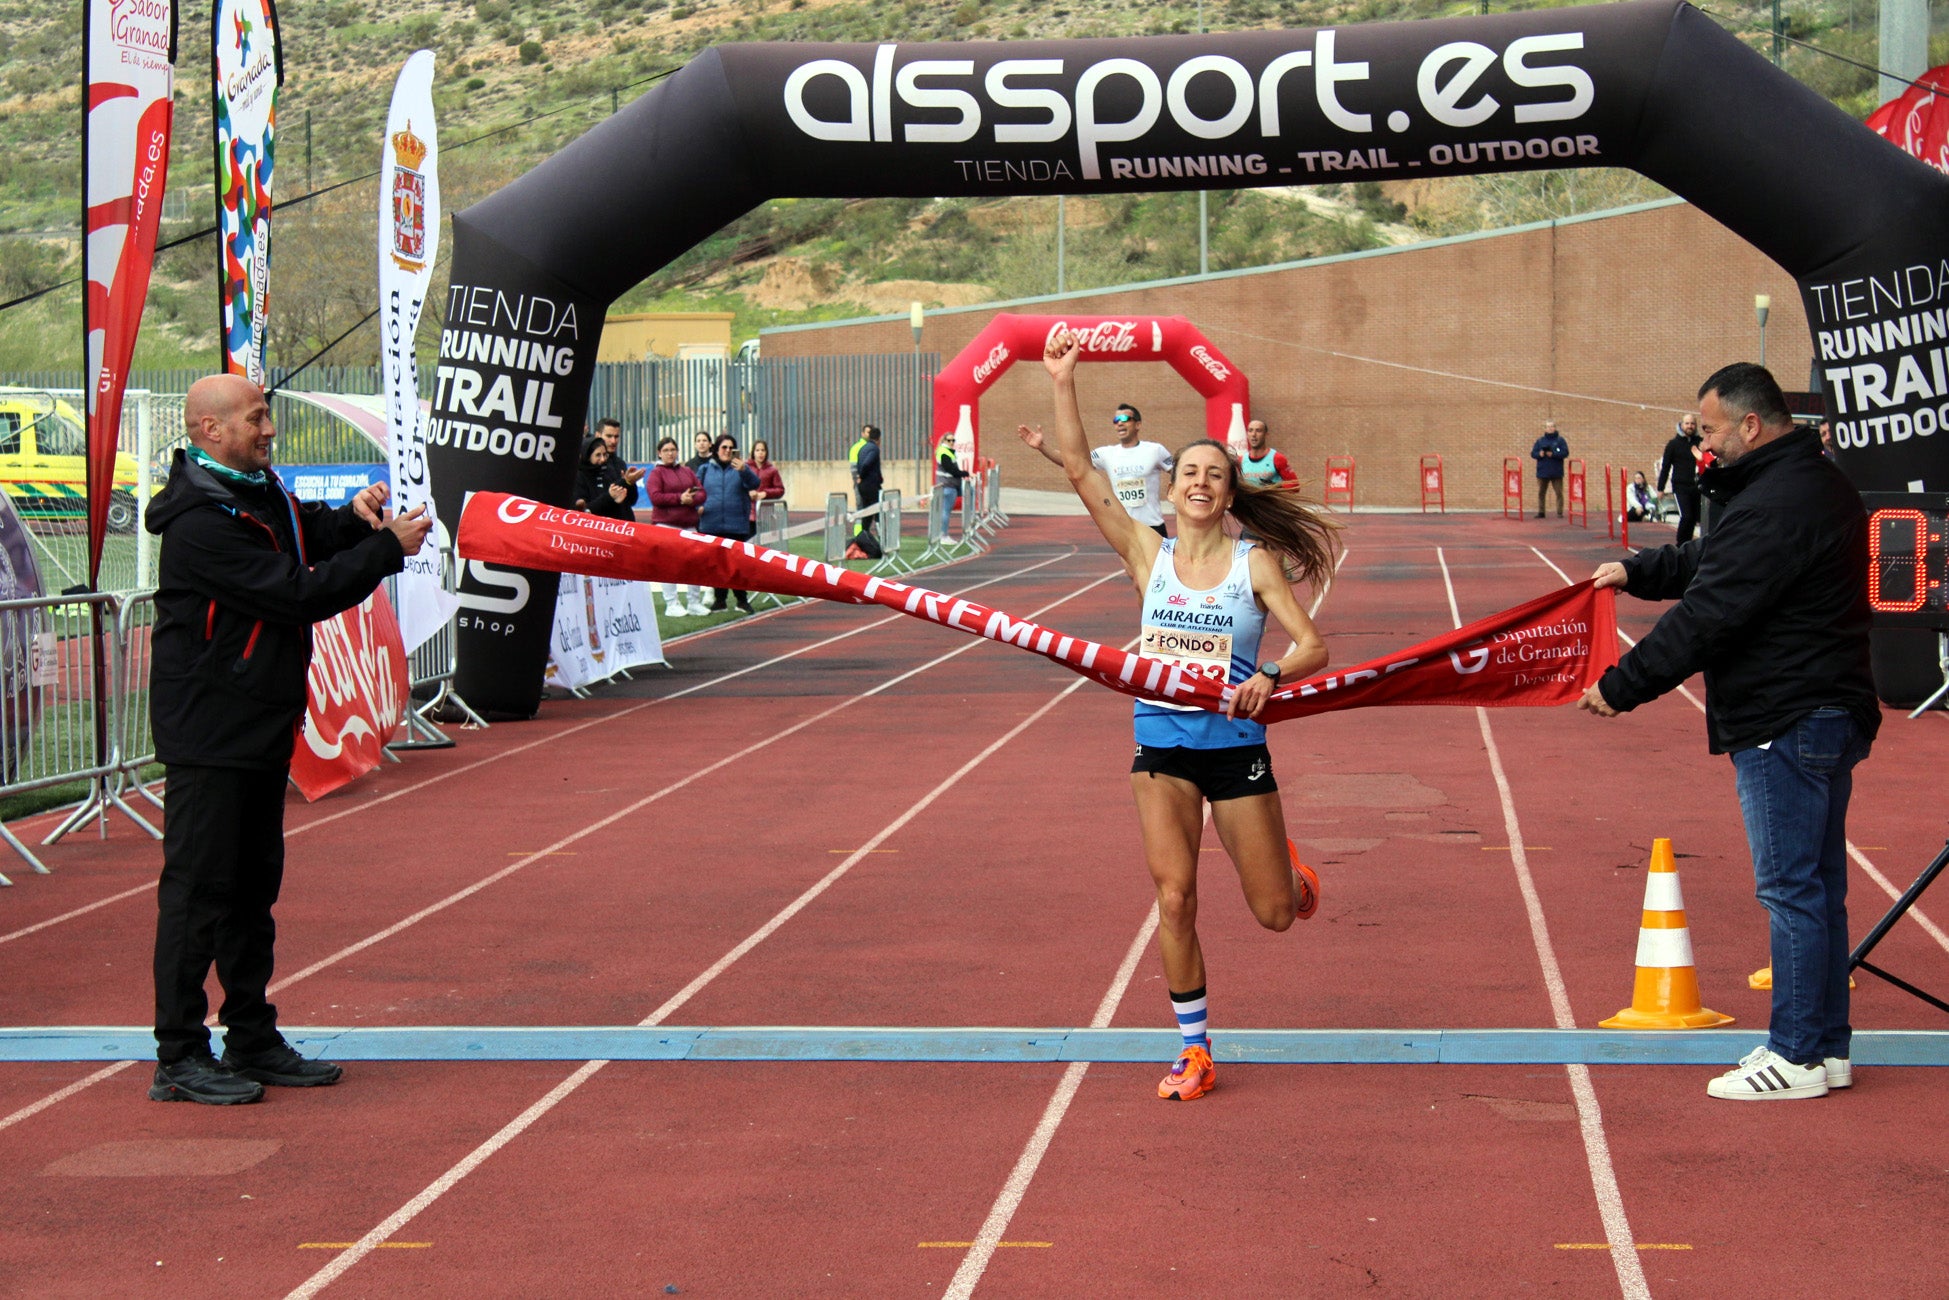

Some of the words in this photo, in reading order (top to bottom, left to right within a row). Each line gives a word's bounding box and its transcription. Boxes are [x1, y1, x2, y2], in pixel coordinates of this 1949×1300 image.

[228, 51, 272, 102] Granada
[784, 30, 1595, 180] alssport.es
[953, 159, 1075, 182] TIENDA
[1110, 153, 1268, 179] RUNNING
[1298, 148, 1399, 172] TRAIL
[1429, 135, 1602, 166] OUTDOOR
[449, 285, 578, 341] TIENDA
[440, 329, 575, 376] RUNNING
[1045, 321, 1138, 352] Cca-Cola
[1818, 308, 1949, 361] RUNNIN
[973, 341, 1010, 384] Coca-Cola
[1190, 345, 1231, 382] Coca-Cola
[1825, 347, 1949, 414] TRAI
[435, 366, 563, 428] TRAIL
[426, 417, 556, 462] OUTDOOR
[1119, 489, 1145, 501] 3095
[539, 508, 560, 523] de
[562, 510, 636, 537] Granada
[551, 534, 615, 558] Deportes
[459, 616, 514, 636] shop
[1151, 608, 1234, 628] MARACENA
[1492, 618, 1588, 644] Diputación
[1159, 635, 1215, 653] FONDO
[1496, 646, 1516, 664] de
[1518, 639, 1590, 662] Granada
[1514, 672, 1576, 687] Deportes
